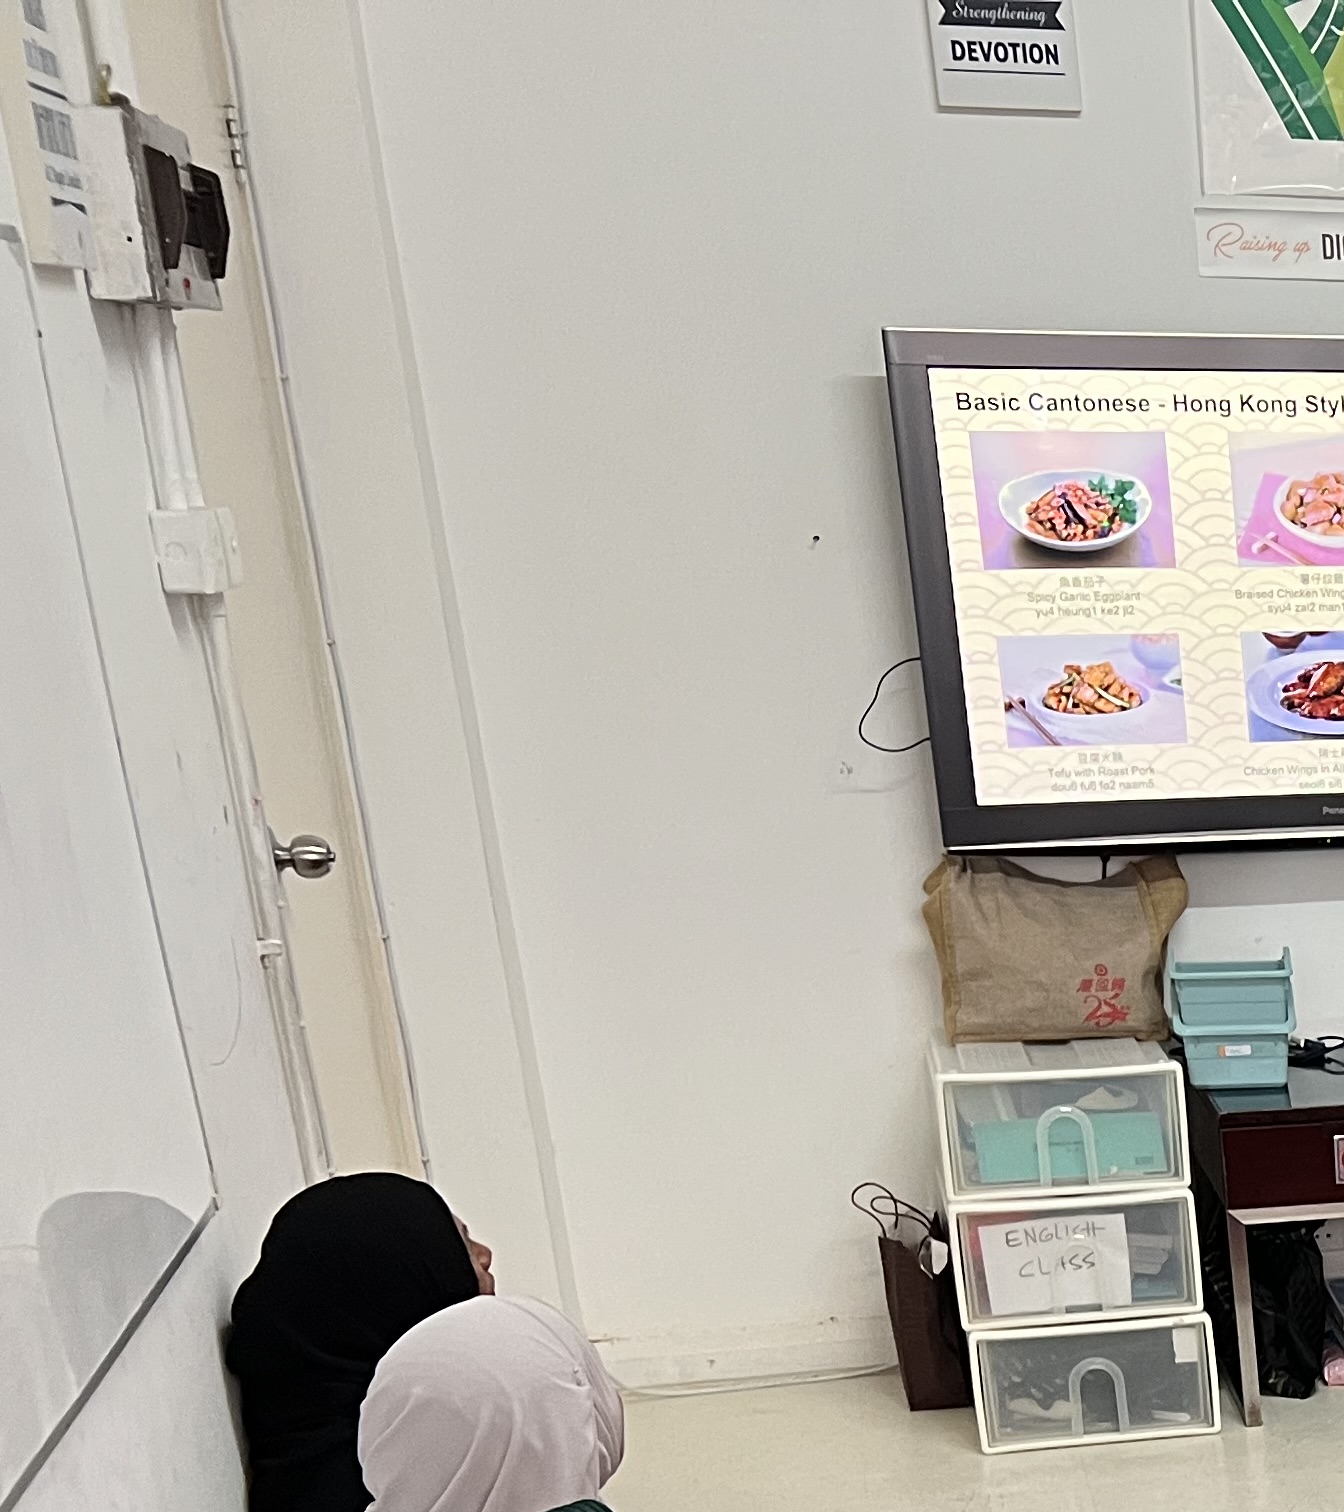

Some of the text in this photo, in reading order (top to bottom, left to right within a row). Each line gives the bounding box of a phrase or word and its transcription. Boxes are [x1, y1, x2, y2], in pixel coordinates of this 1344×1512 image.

[952, 0, 1048, 27] Strengthening
[950, 39, 1060, 65] DEVOTION
[1206, 222, 1289, 260] Raising
[1292, 238, 1312, 262] up
[956, 391, 1020, 413] Basic
[1028, 392, 1150, 413] Cantonese
[1173, 393, 1232, 417] Hong
[1240, 393, 1298, 418] Kong
[1026, 591, 1141, 604] Spicy Garlic Eggplant
[1234, 588, 1274, 600] Braised
[1277, 587, 1319, 599] Chicken
[1047, 764, 1156, 778] Tofu with Roast Pork
[1243, 764, 1285, 776] Chicken
[1287, 763, 1318, 778] Wings
